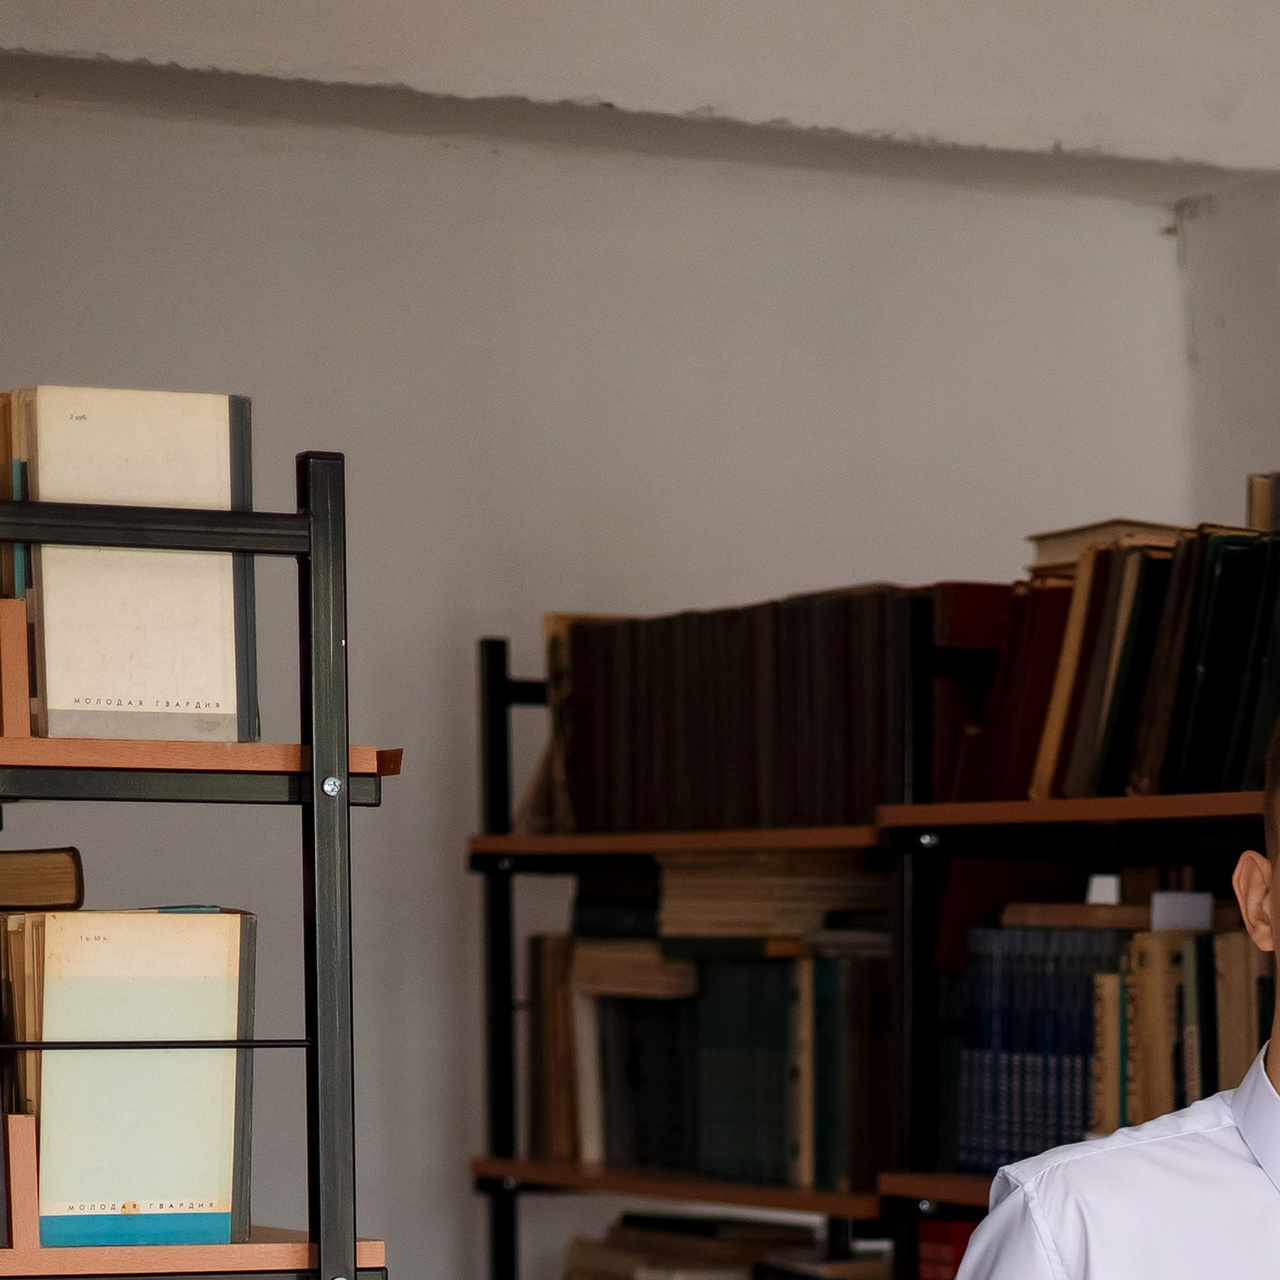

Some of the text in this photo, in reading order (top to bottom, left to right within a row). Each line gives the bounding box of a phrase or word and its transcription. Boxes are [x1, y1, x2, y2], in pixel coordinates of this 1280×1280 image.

[73, 698, 221, 710] МОЛОДАЯ ГВАРДИЯ
[149, 1202, 214, 1210] ГВАРДИЯ
